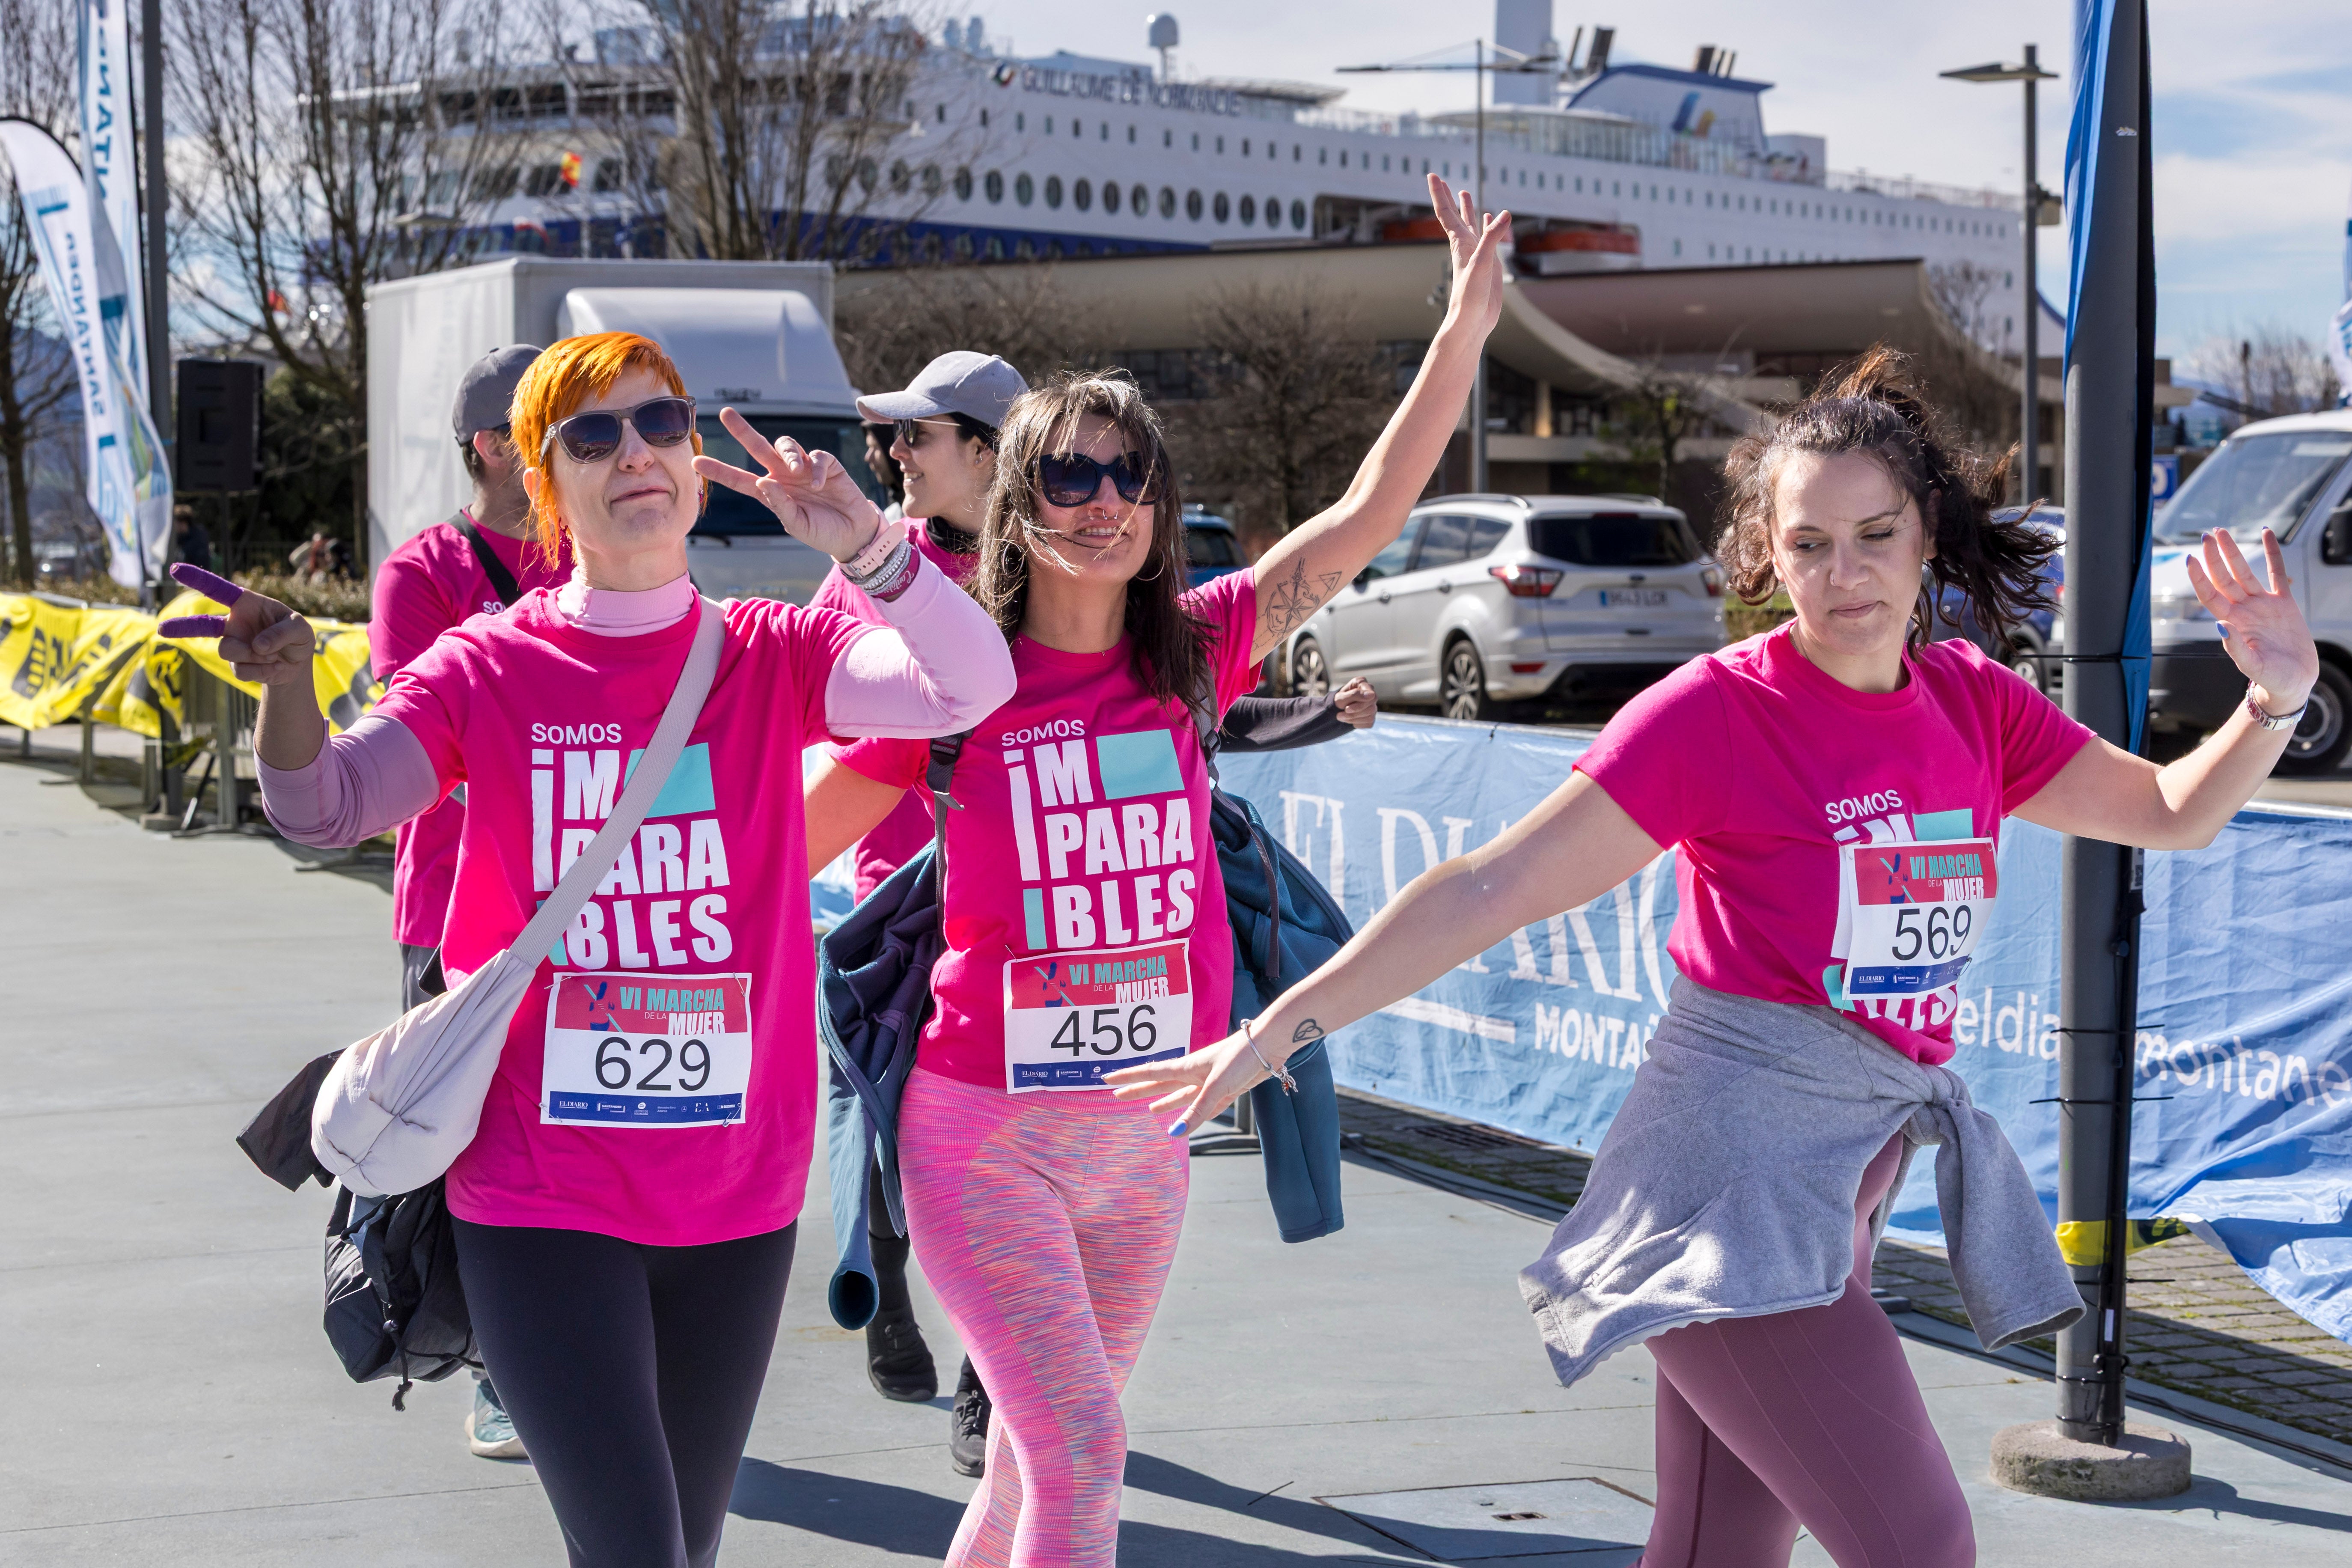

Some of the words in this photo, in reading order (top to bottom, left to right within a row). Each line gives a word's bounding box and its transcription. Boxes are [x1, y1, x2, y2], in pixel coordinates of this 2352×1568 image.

[531, 723, 622, 745] SOMOS
[1001, 719, 1085, 747] SOMOS
[1825, 789, 1903, 824] SOMOS
[1044, 797, 1195, 879] PARA
[1909, 856, 1926, 880] VI
[1928, 854, 1983, 879] MARCHA
[1928, 879, 1935, 887] DE
[1943, 877, 1984, 902] MUJER
[1892, 905, 1971, 961] 569
[1068, 964, 1089, 985] VI
[1094, 955, 1168, 984] MARCHA
[619, 986, 642, 1010] VI
[646, 988, 725, 1012] MARCHA
[1115, 976, 1169, 1004] MUJER
[644, 1012, 655, 1020] DE
[656, 1012, 667, 1020] LA
[667, 1012, 726, 1035] MUJER
[1050, 1004, 1156, 1057] 456
[595, 1036, 711, 1092] 629
